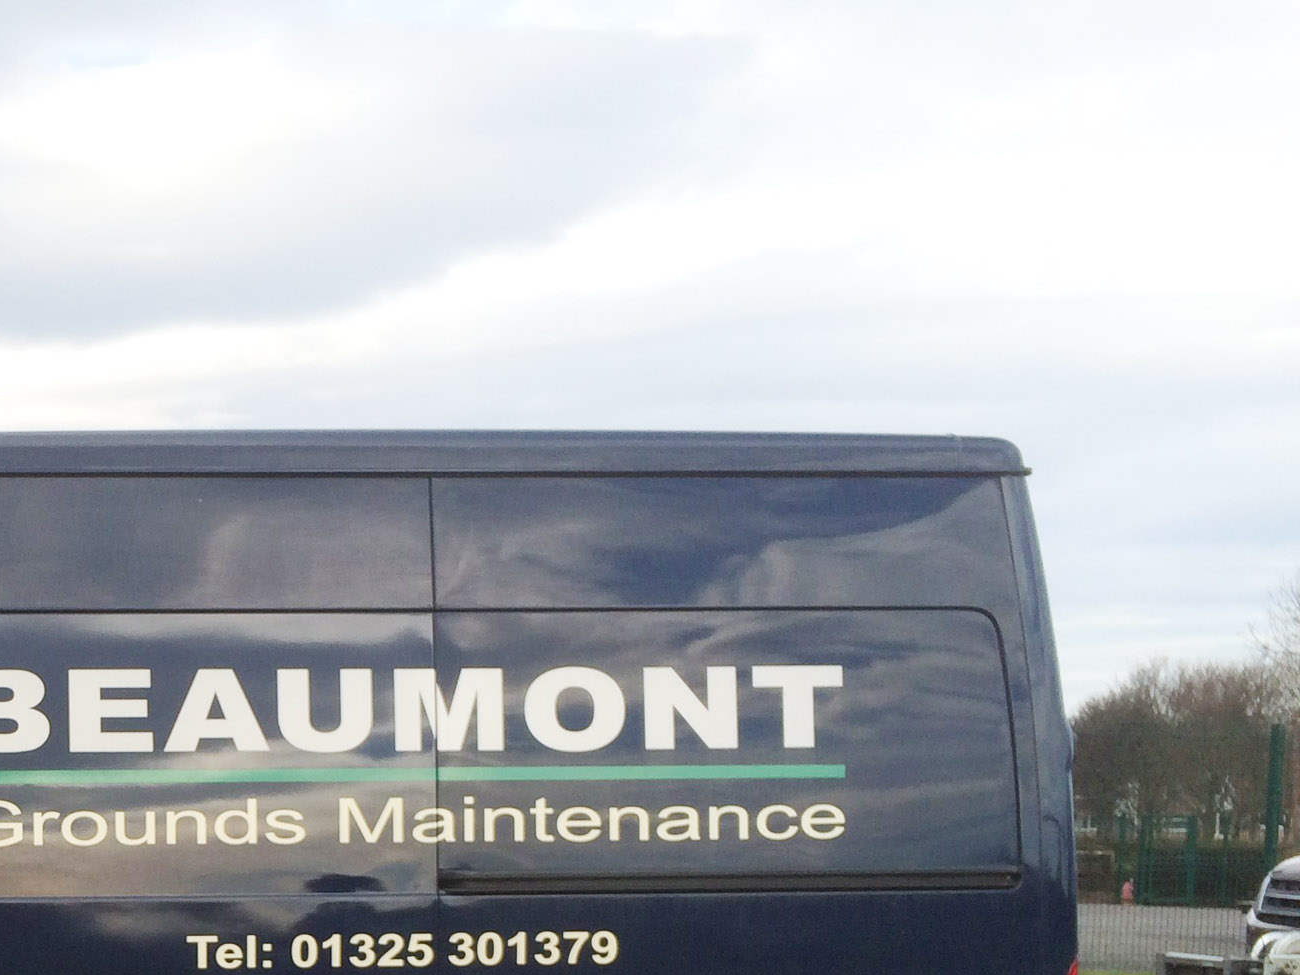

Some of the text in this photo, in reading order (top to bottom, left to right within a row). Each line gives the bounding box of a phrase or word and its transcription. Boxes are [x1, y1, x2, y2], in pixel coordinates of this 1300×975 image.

[338, 795, 847, 845] Maintenance
[185, 931, 619, 969] Tel: 01325 301379
